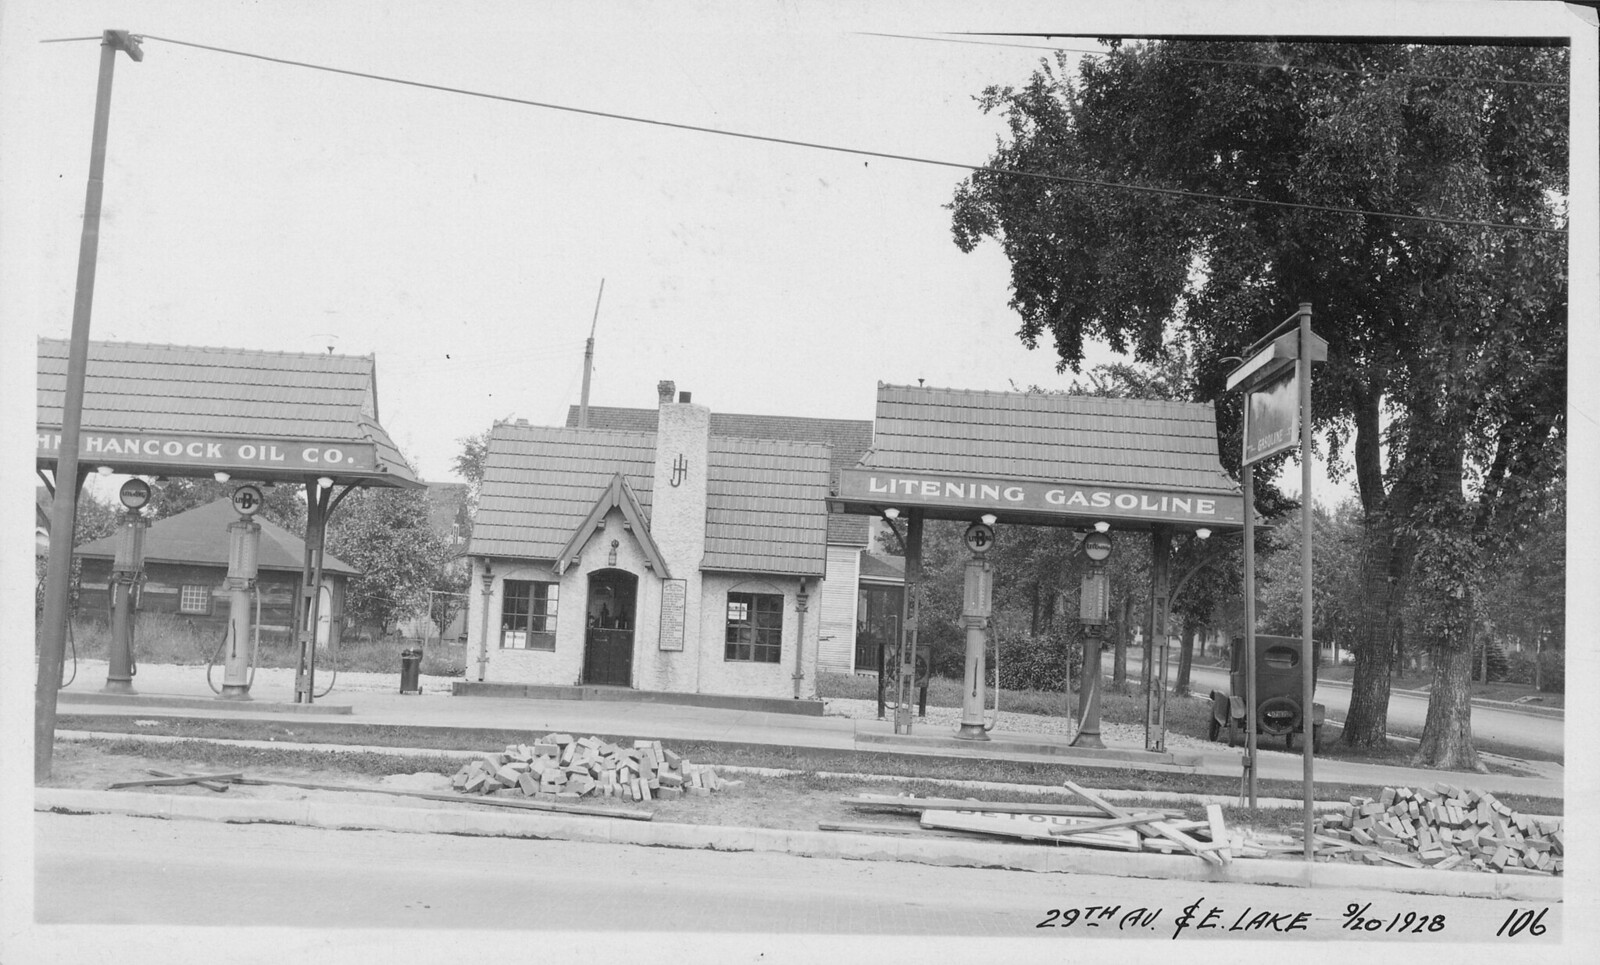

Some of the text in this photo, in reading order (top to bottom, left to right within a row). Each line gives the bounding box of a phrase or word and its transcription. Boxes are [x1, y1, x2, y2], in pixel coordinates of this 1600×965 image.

[85, 436, 223, 459] HANCOCK
[238, 444, 285, 462] OIL
[302, 447, 355, 465] CO.
[868, 477, 1216, 515] LITENING GASOLINE
